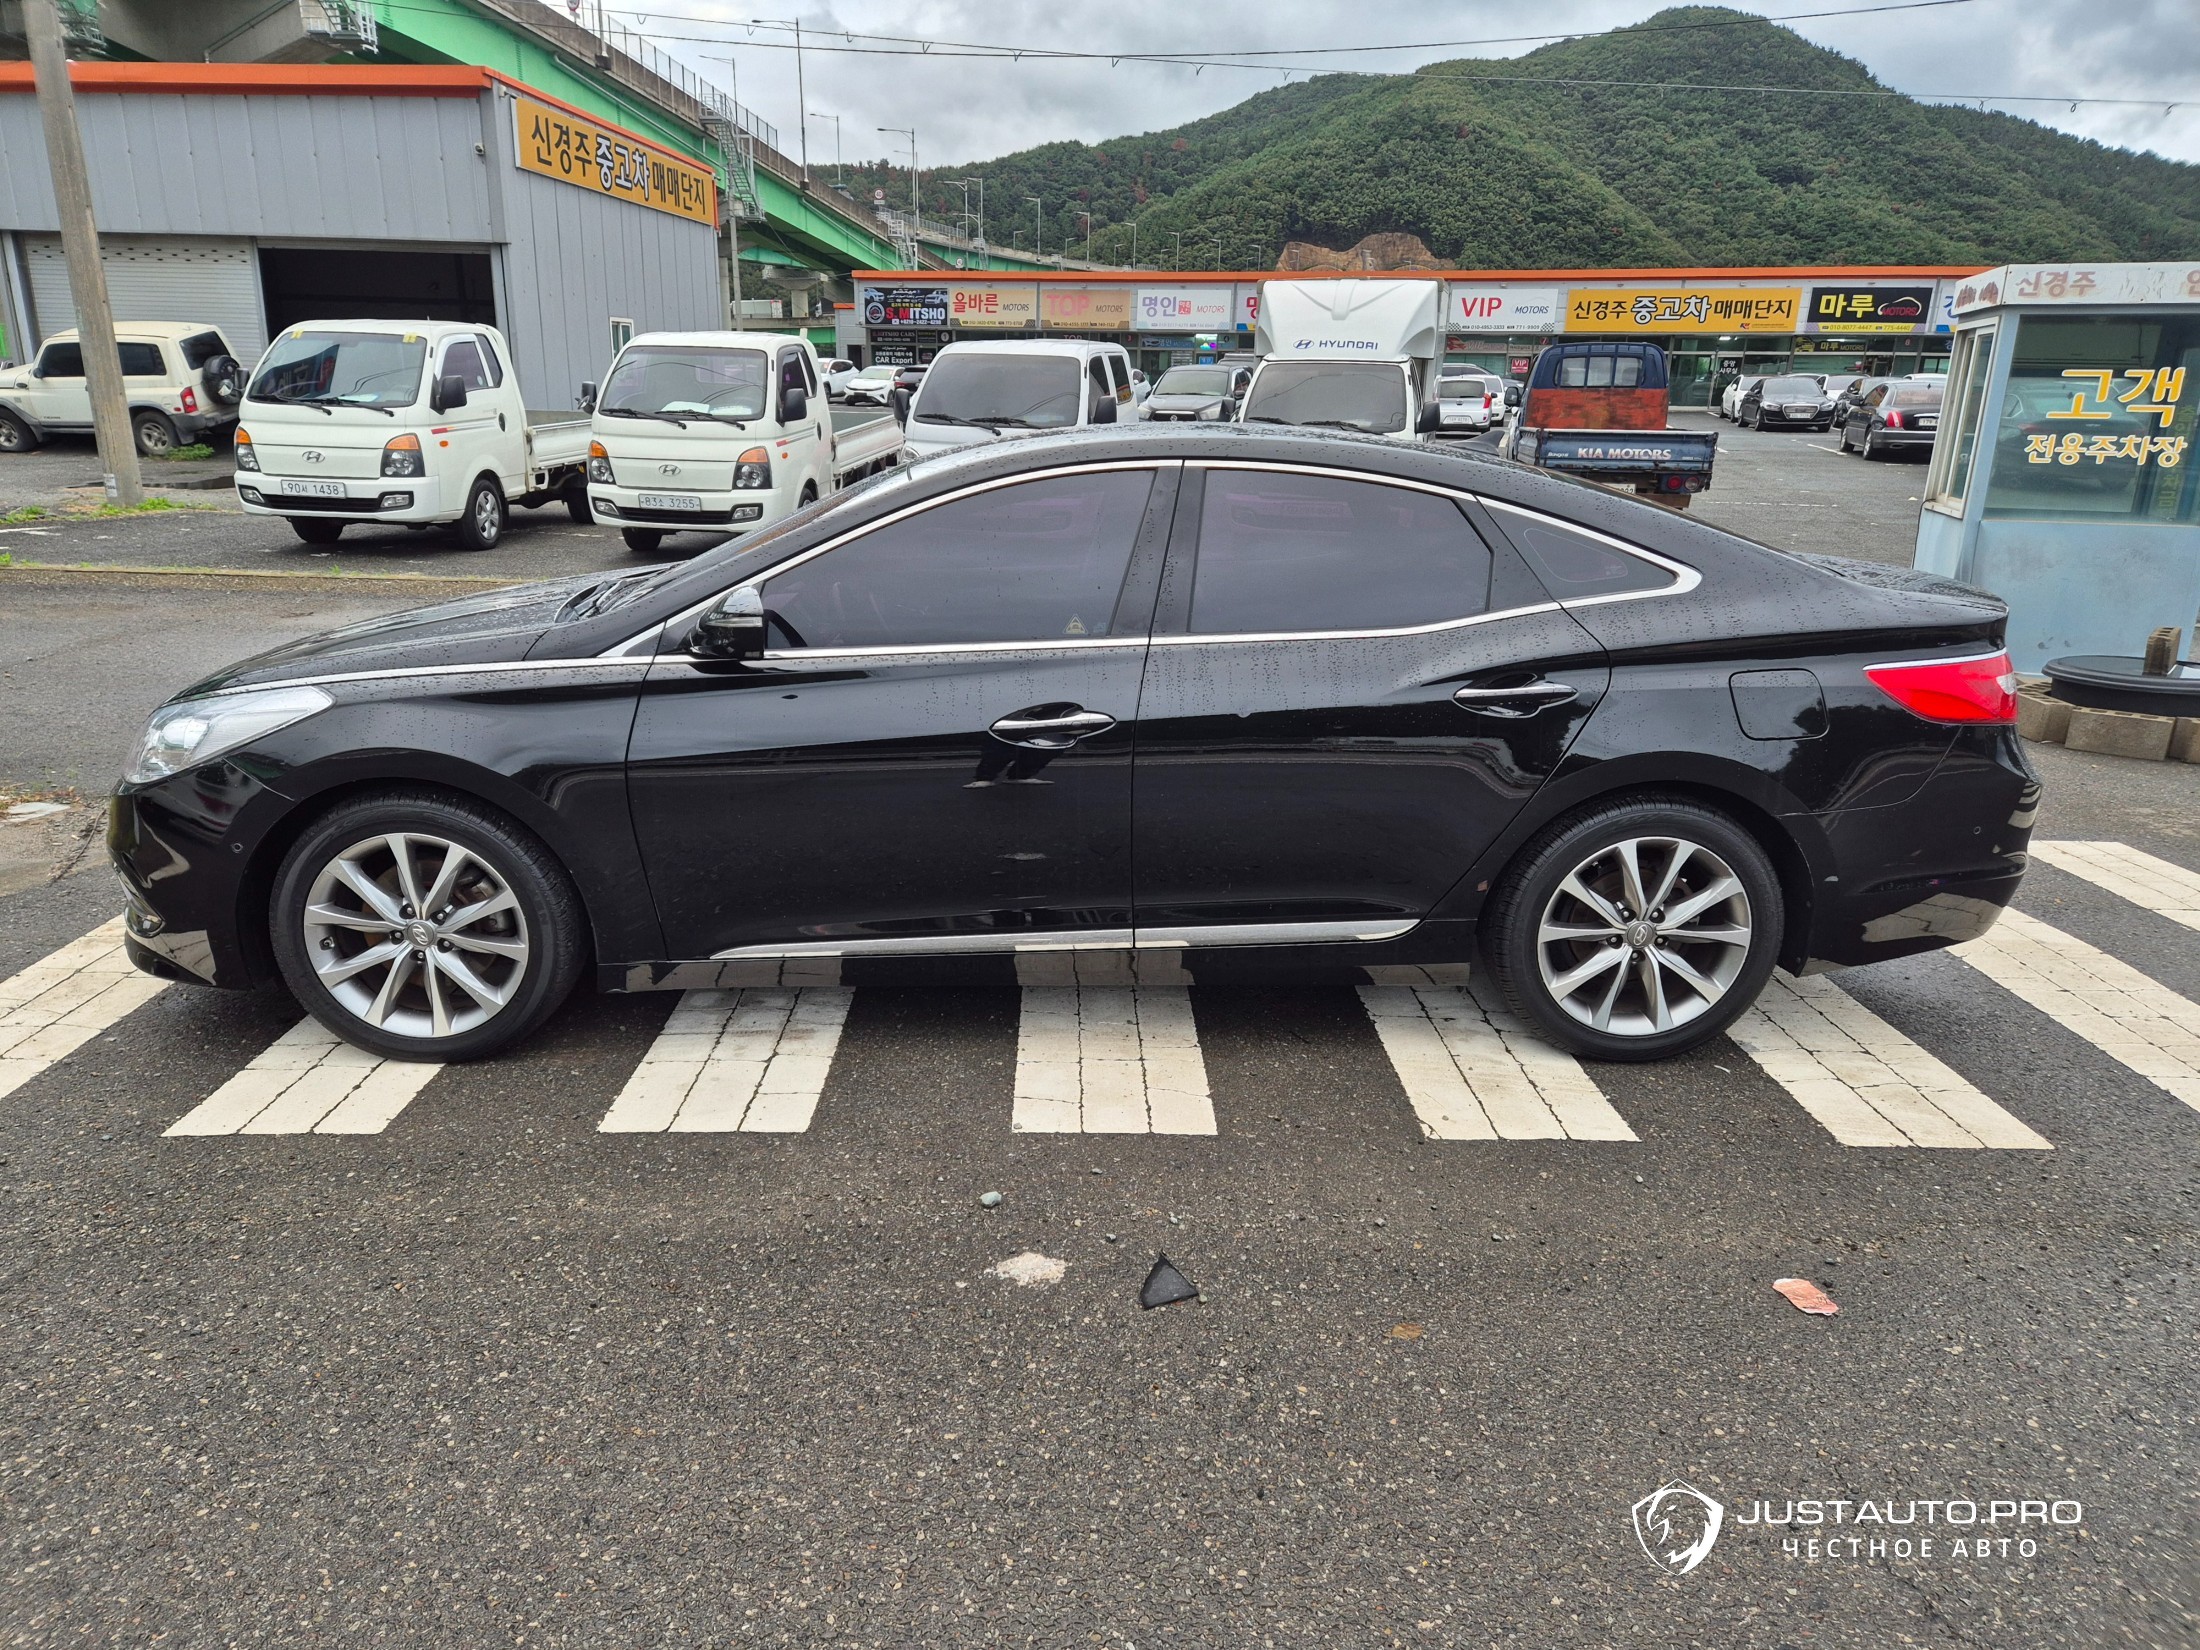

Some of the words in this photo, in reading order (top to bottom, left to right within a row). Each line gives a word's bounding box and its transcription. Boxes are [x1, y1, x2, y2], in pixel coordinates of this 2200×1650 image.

[531, 114, 592, 178] 신경주
[595, 132, 650, 201] 중고차
[652, 160, 706, 216] 매매단지
[2015, 269, 2098, 299] 신경주
[952, 292, 999, 313] 올바른
[1002, 303, 1030, 311] MOTORS
[1046, 294, 1090, 316] TOP
[1095, 304, 1123, 313] MOTORS
[1142, 296, 1177, 317] 명인
[1196, 305, 1225, 314] MOTORS
[1461, 297, 1502, 317] VIP
[1514, 305, 1550, 315] MOTORS
[1573, 300, 1628, 321] 신경주
[1630, 294, 1713, 325] 중고차
[1713, 298, 1793, 319] 매매단지
[1819, 293, 1875, 319] 마루
[1881, 306, 1918, 317] MOTORS
[1318, 339, 1379, 350] HYUNDAI
[1820, 342, 1839, 350] 마루
[891, 356, 913, 364] Export
[1514, 359, 1527, 367] VIP
[1722, 359, 1737, 367] 중앙
[2045, 366, 2187, 428] 고객
[1577, 447, 1604, 459] KIA
[1607, 448, 1672, 460] MOTORS
[2024, 432, 2189, 468] 전용주차장
[312, 484, 340, 496] 1438
[669, 498, 695, 509] 3255
